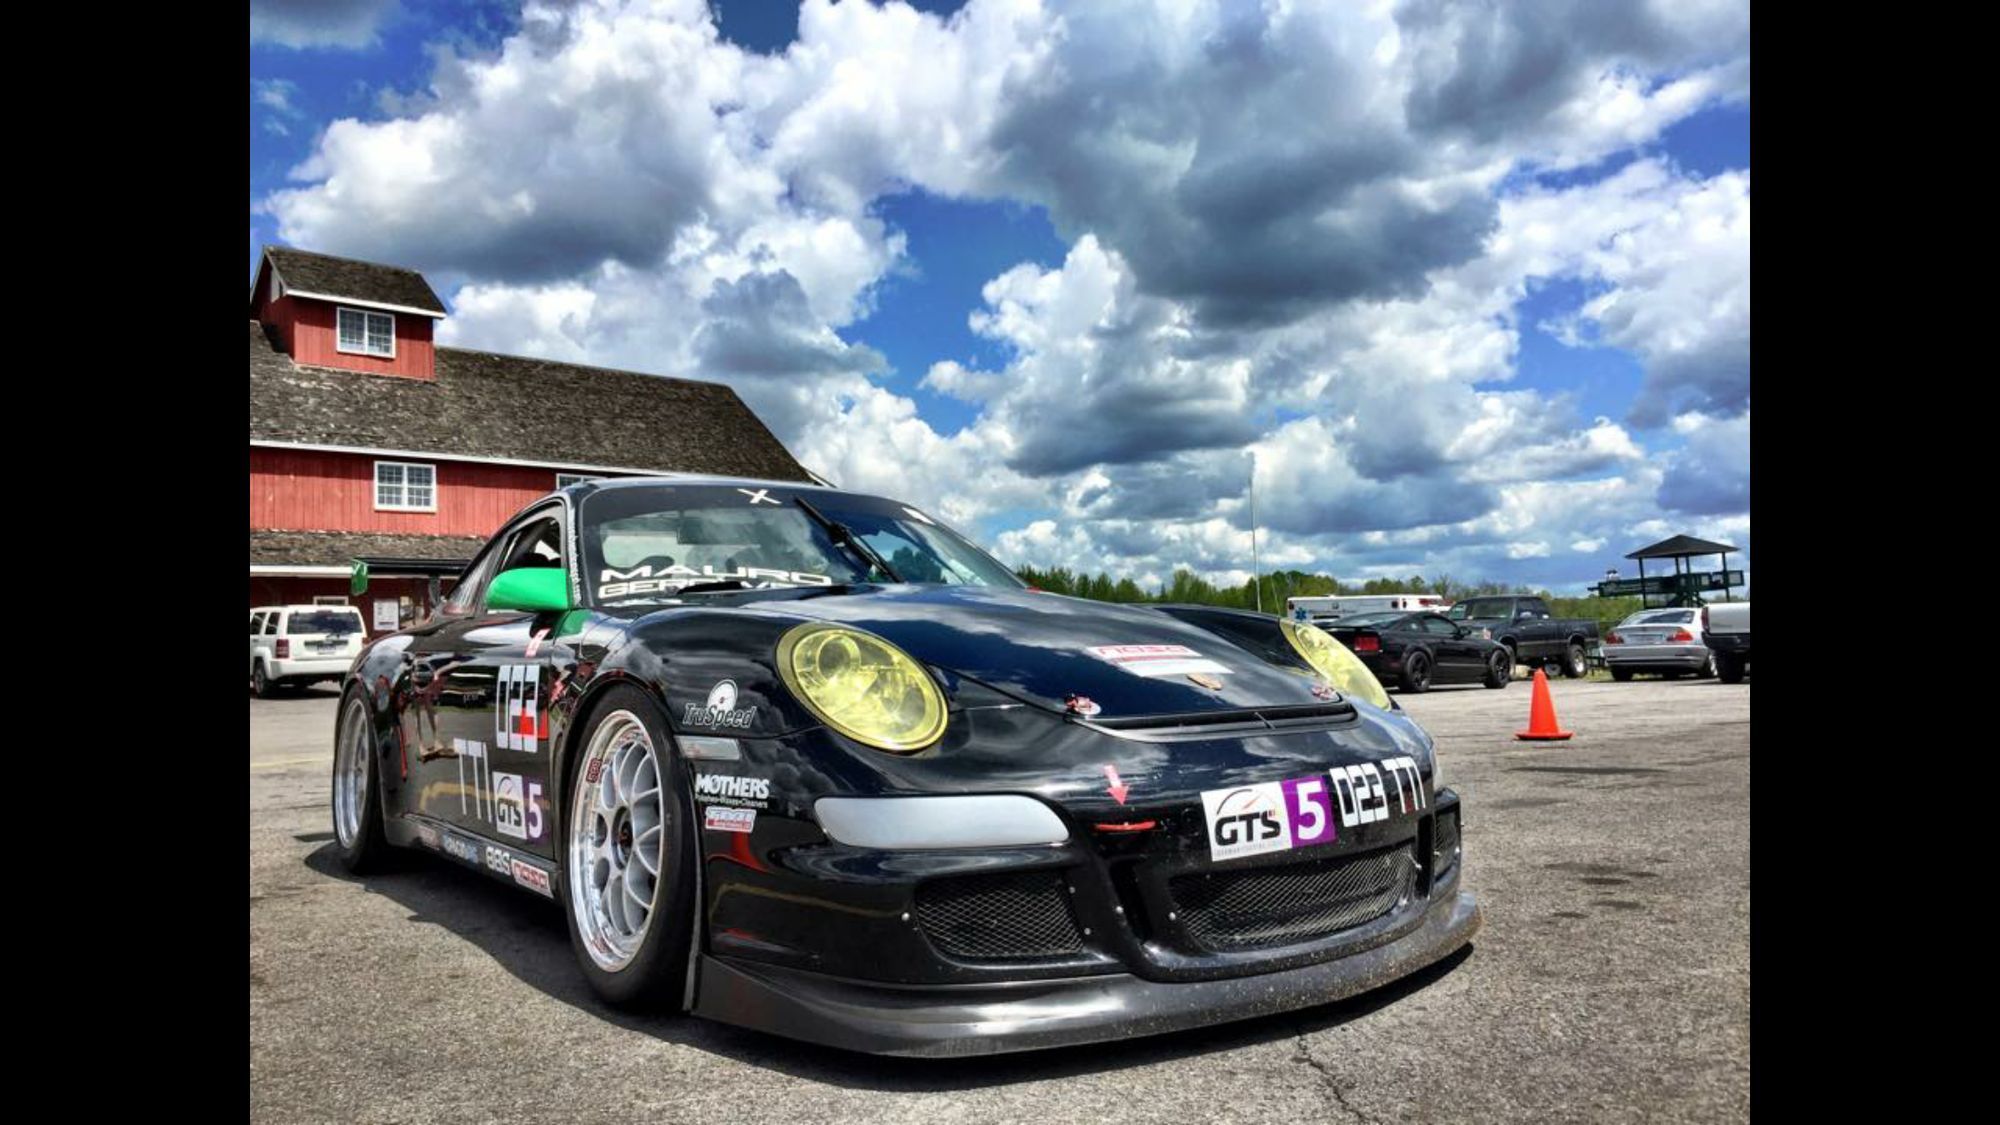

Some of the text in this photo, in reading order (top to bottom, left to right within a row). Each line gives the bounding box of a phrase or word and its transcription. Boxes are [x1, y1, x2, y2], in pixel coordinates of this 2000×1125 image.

[601, 565, 832, 586] MAURO
[496, 664, 540, 753] 023
[682, 702, 757, 730] TruSpeed
[695, 773, 770, 799] MOTHERS
[1329, 762, 1389, 827] 023
[497, 783, 543, 838] GTS 5
[1214, 780, 1326, 847] GTS 5
[486, 846, 511, 876] BBS
[514, 862, 549, 889] nasa
